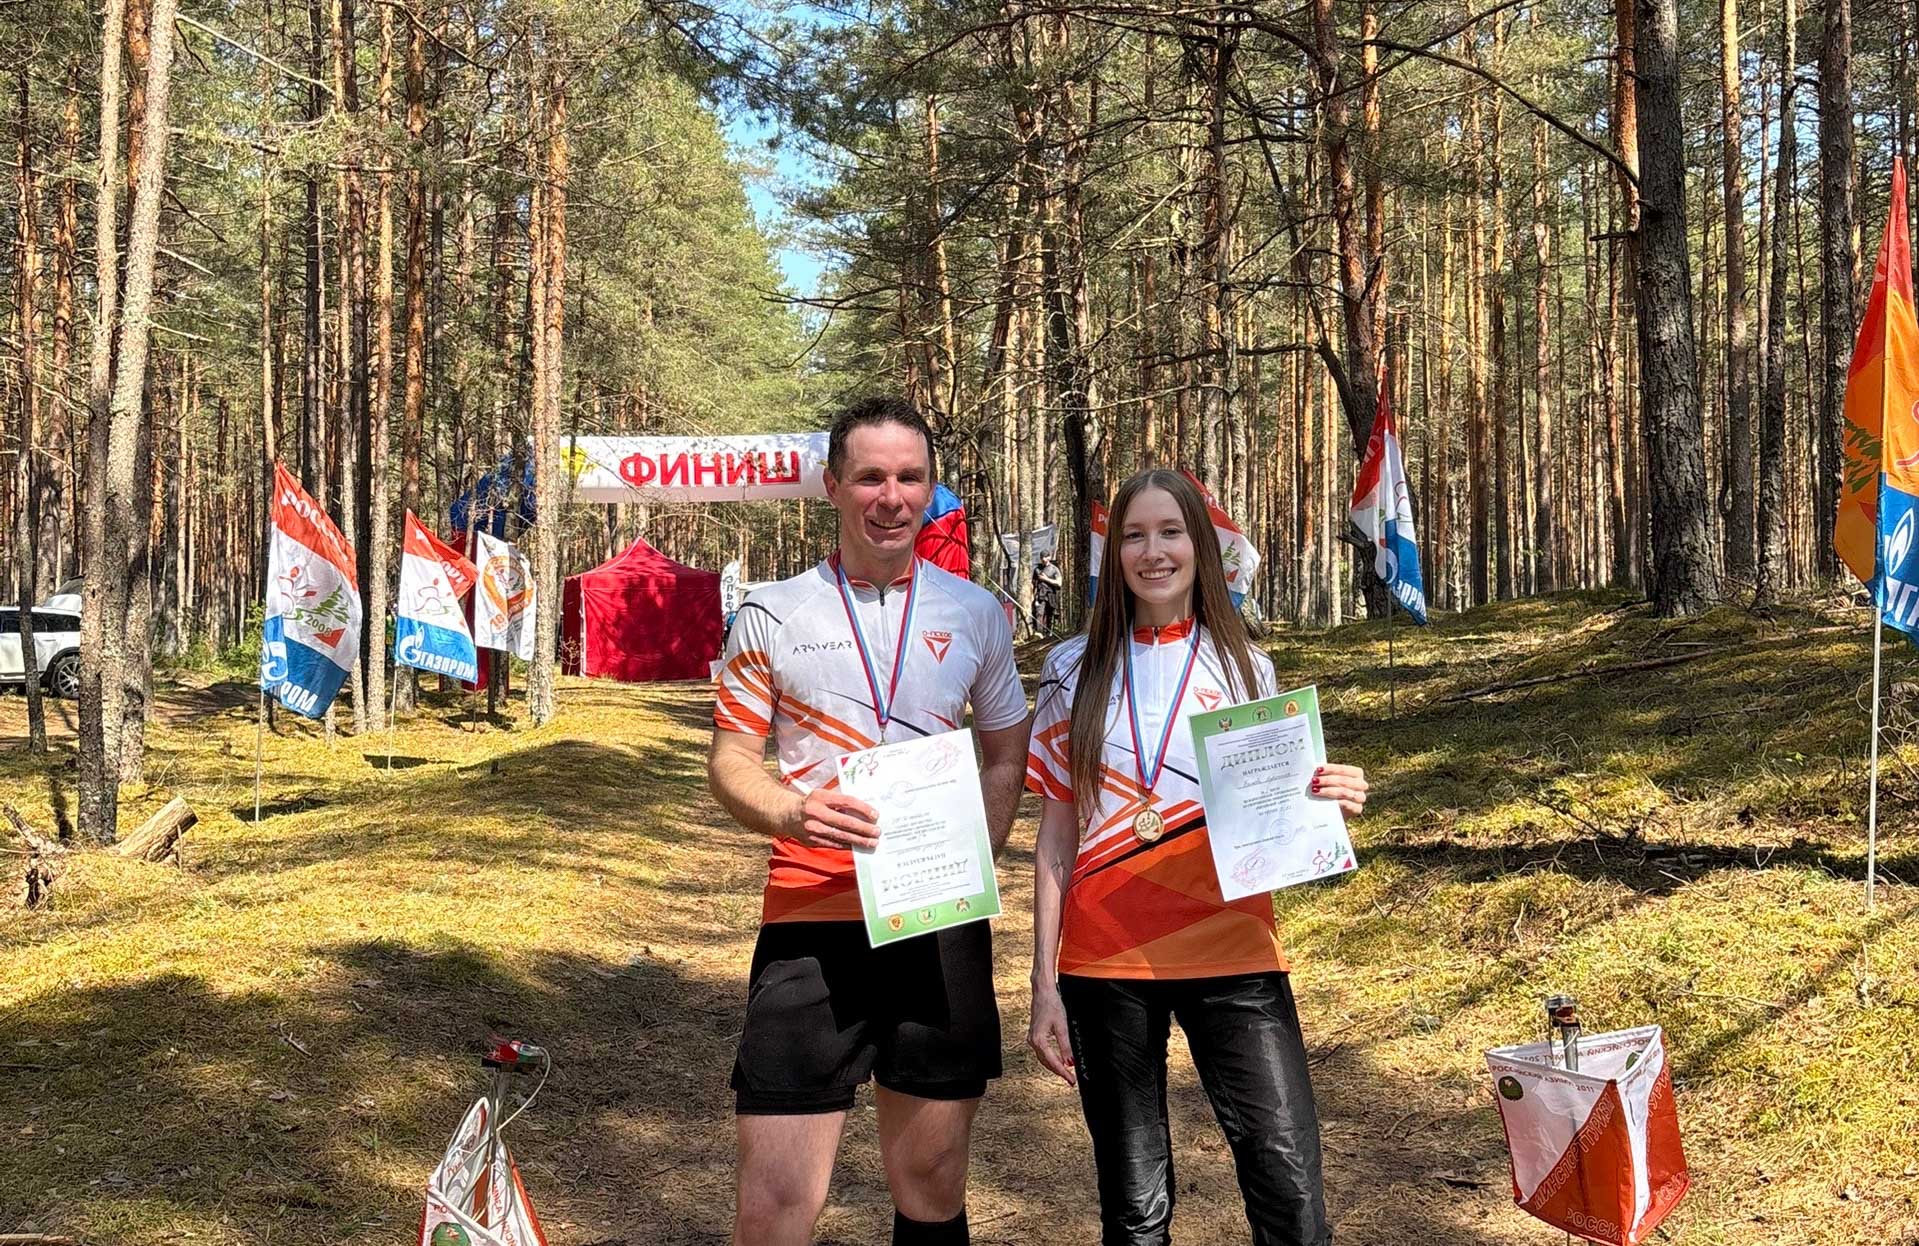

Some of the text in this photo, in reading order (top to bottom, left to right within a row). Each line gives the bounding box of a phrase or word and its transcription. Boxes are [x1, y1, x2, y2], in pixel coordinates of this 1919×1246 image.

[618, 450, 801, 487] ФИНИШ
[306, 614, 333, 636] 2008
[420, 650, 475, 680] ГАЗПРОМ
[1221, 738, 1305, 770] ДИПЛОМ
[1576, 1083, 1595, 1094] 2011
[1564, 1207, 1624, 1241] РОССИ
